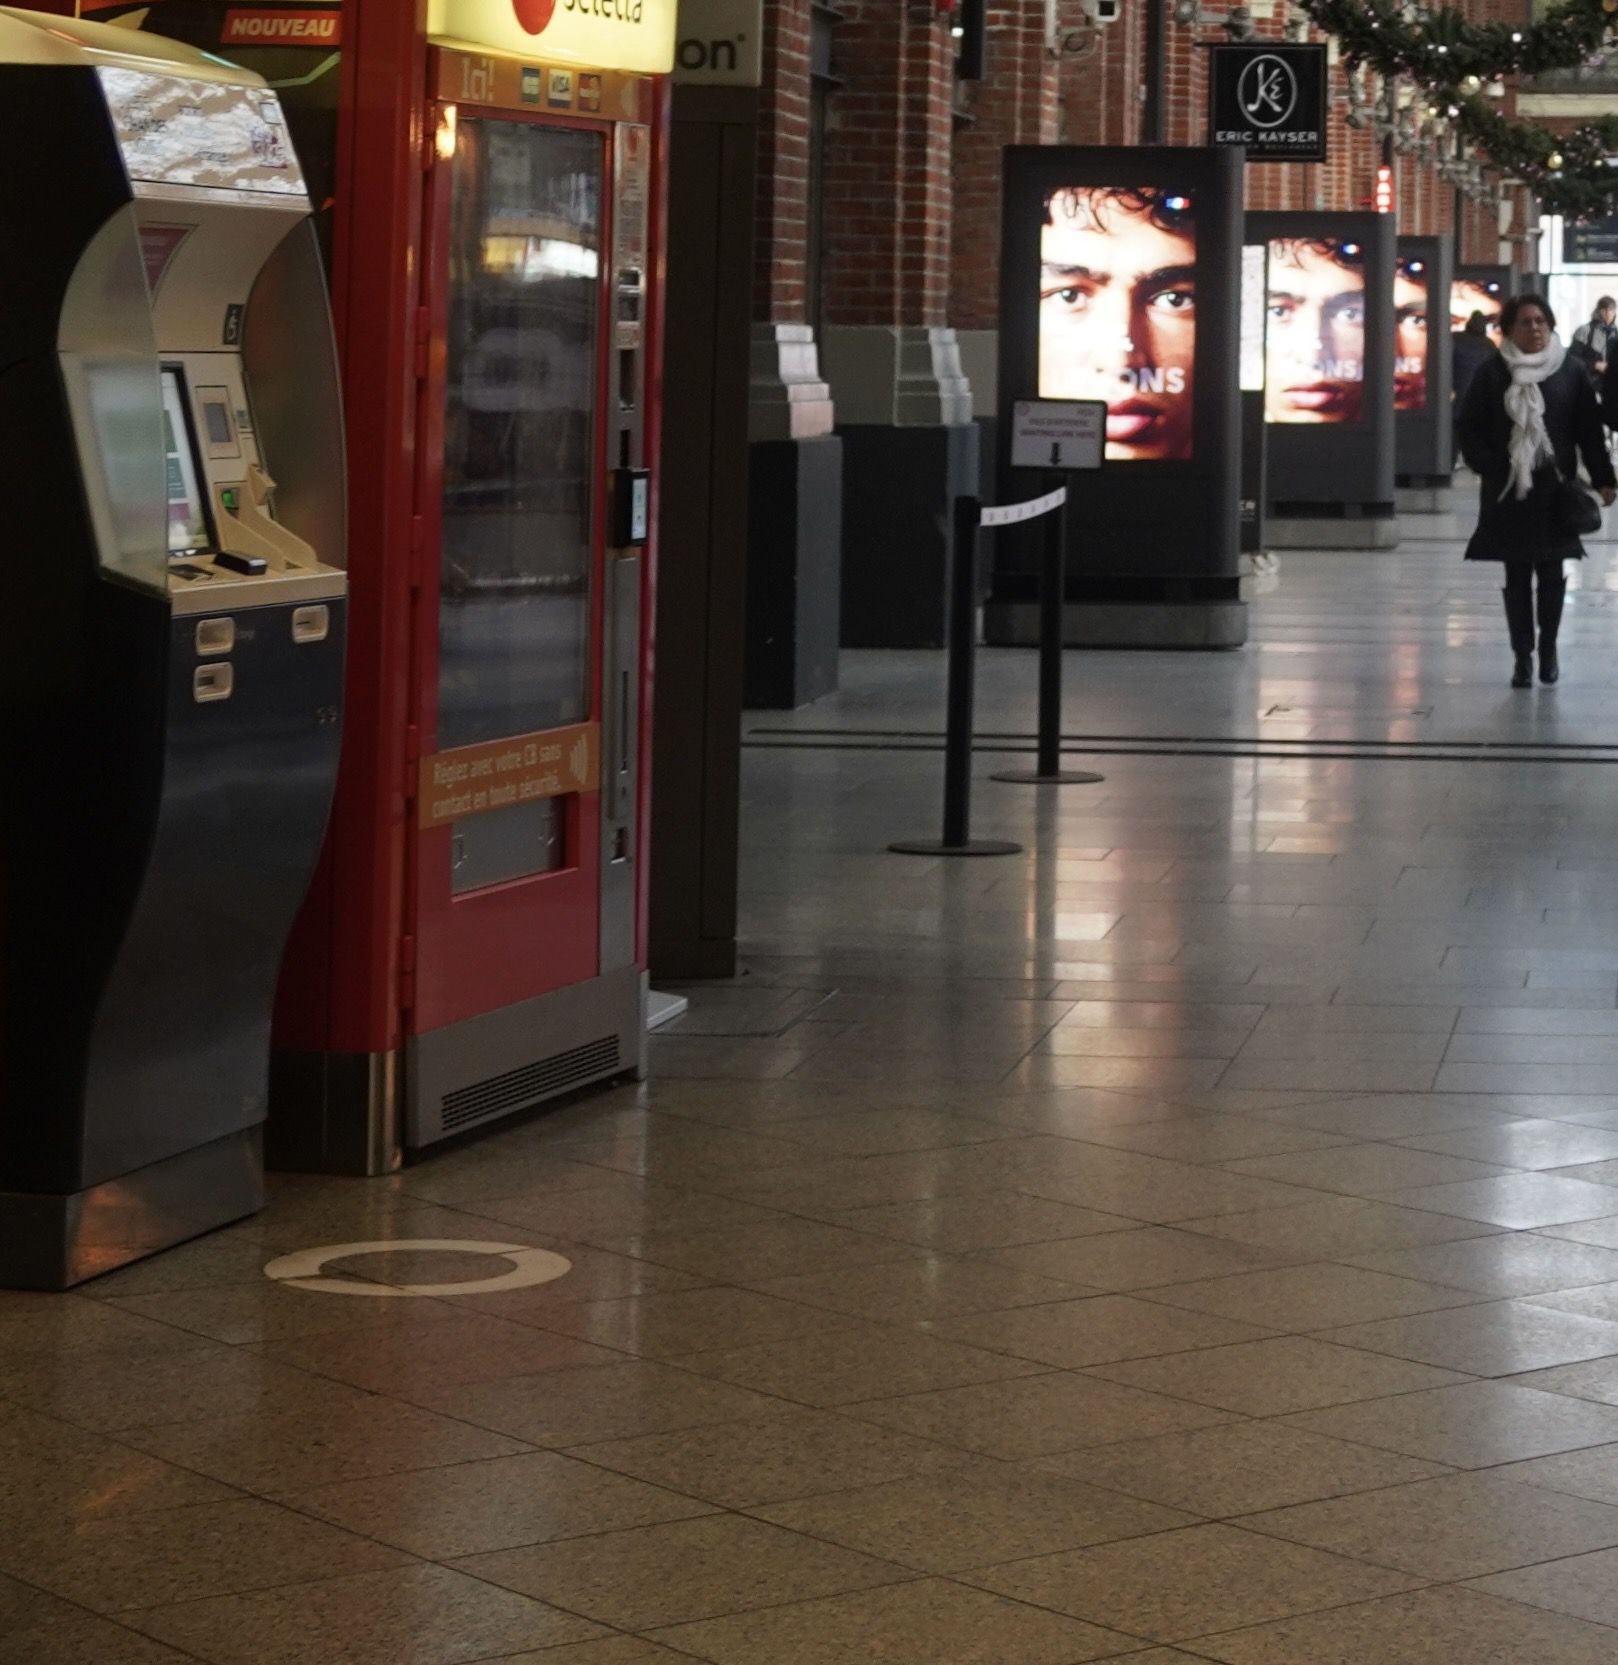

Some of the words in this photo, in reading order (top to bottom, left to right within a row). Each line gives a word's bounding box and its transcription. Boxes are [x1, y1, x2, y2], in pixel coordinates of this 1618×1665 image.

[232, 18, 338, 36] NOUVEAU
[1216, 131, 1252, 142] ERIC
[1258, 131, 1317, 142] KAYSER
